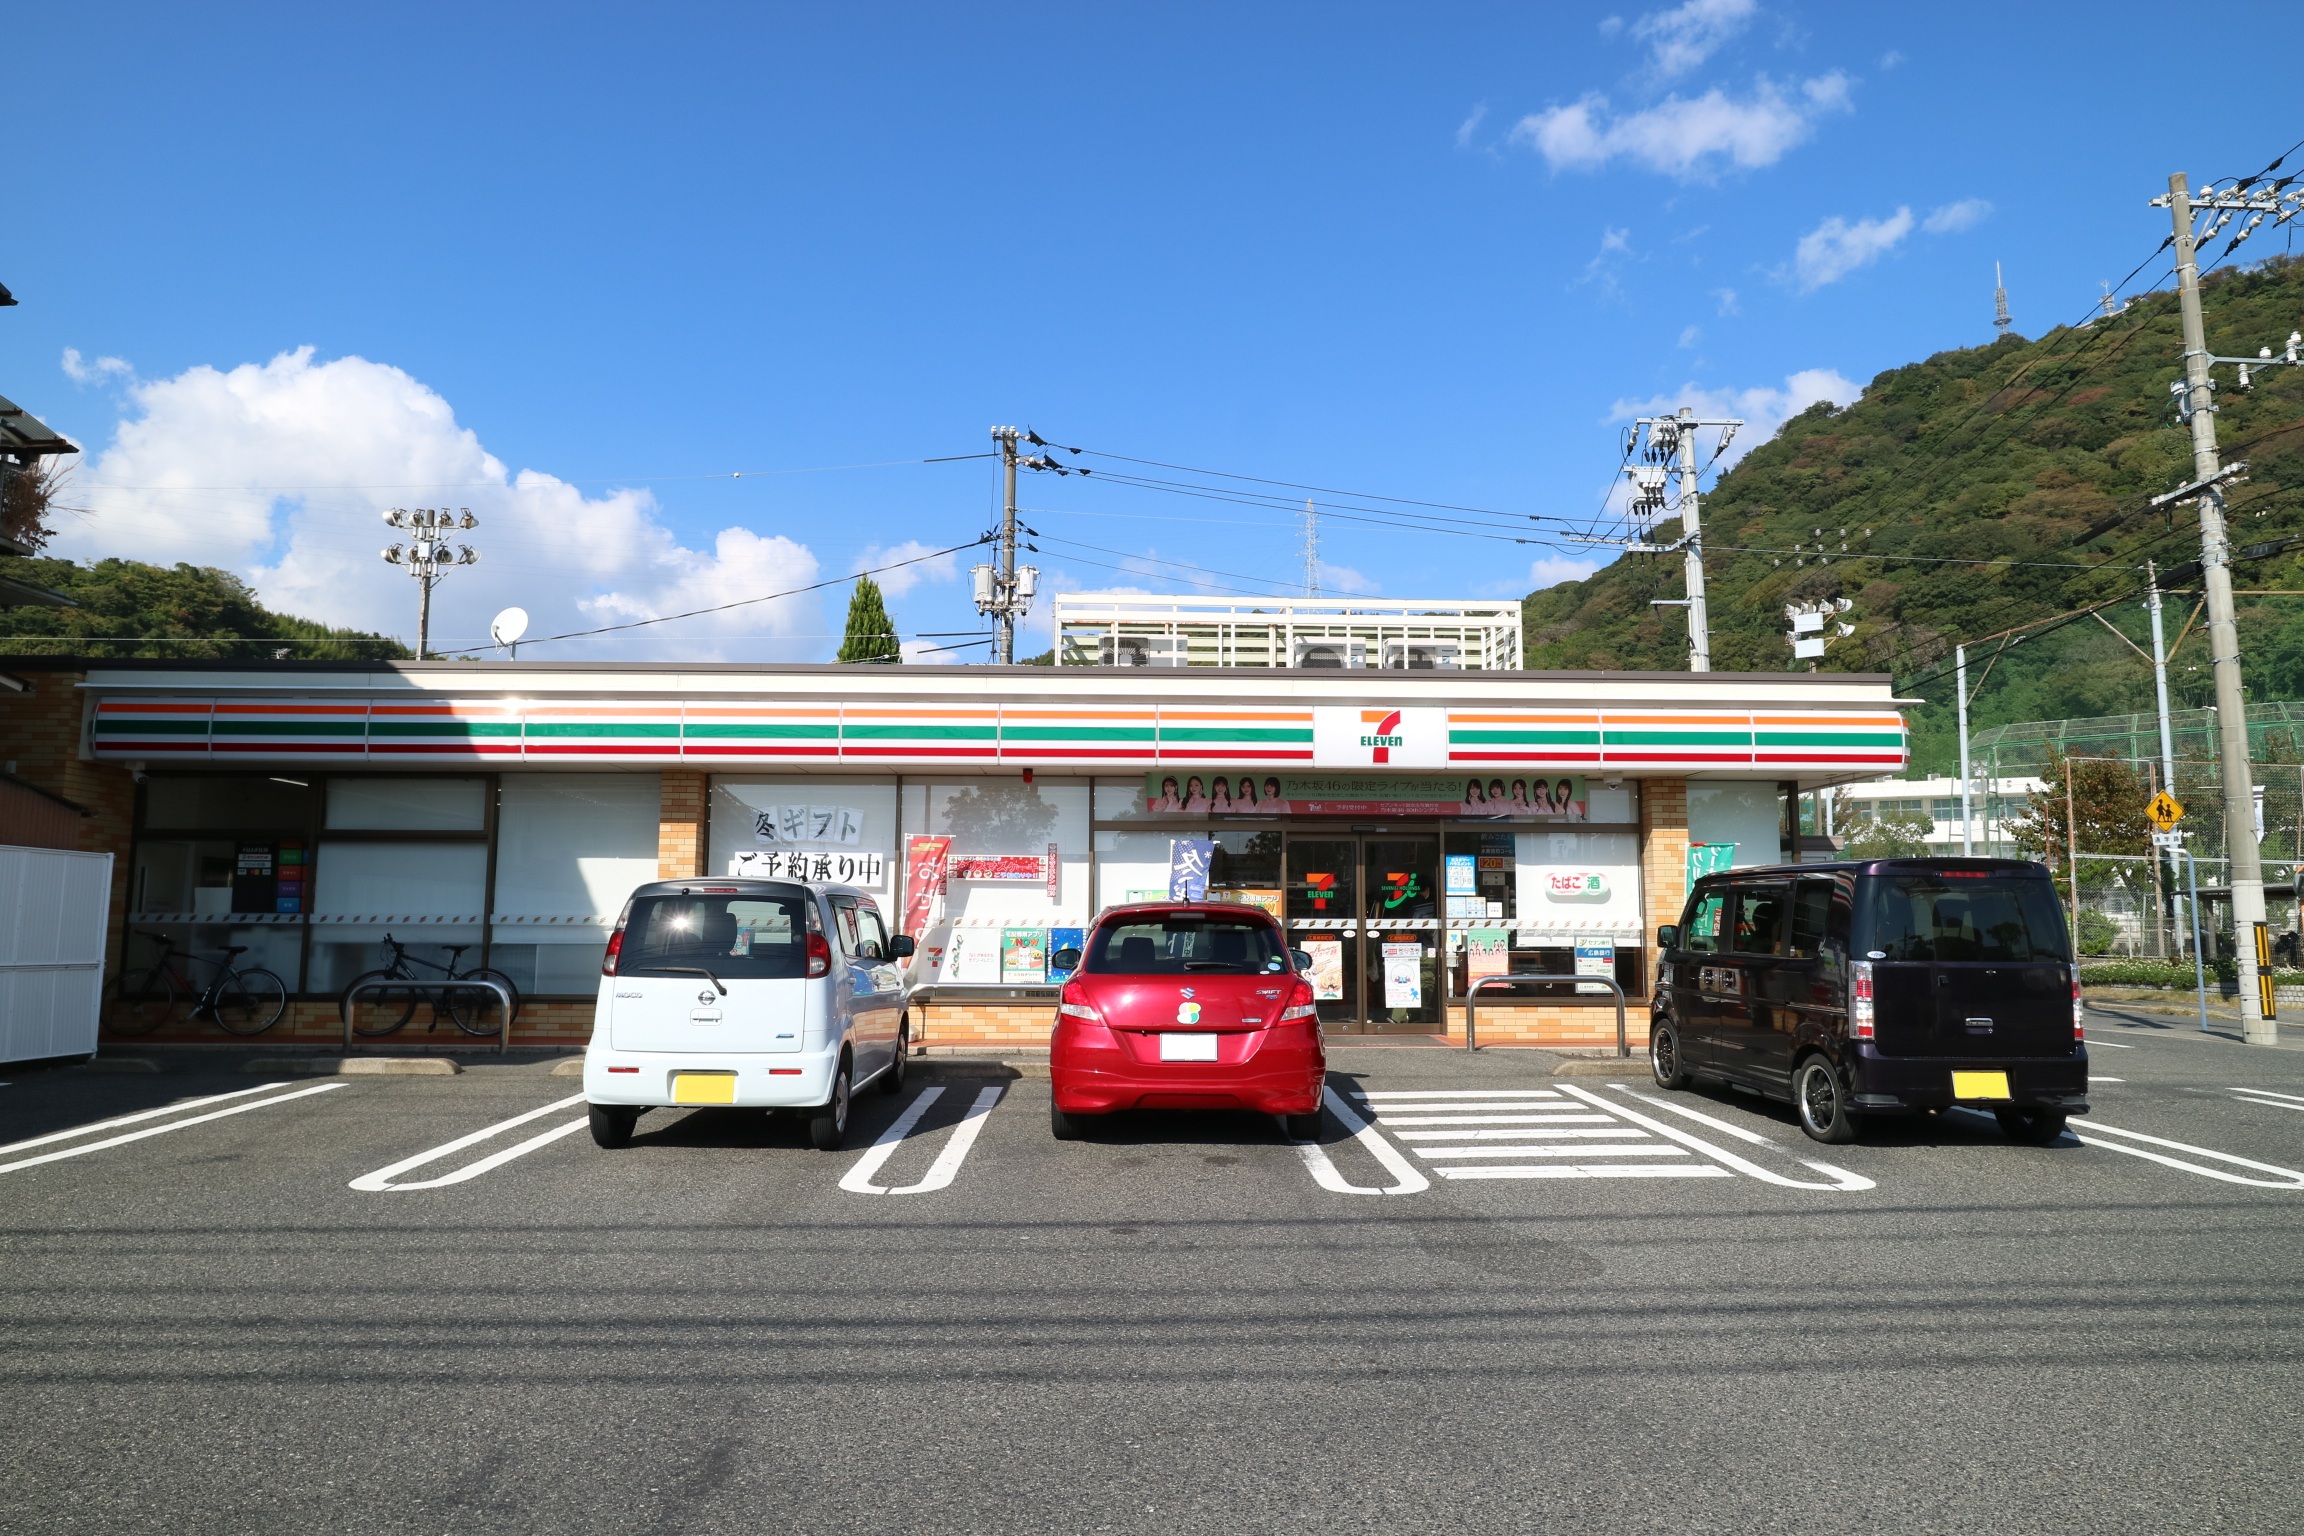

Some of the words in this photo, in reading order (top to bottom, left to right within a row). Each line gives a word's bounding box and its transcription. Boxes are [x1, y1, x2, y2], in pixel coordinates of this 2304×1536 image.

[755, 808, 857, 841] 冬ギフト
[737, 851, 881, 884] ご予約承り中
[958, 861, 1039, 872] クリスマスケーキ
[1551, 876, 1582, 889] たばこ
[1587, 876, 1600, 889] 酒
[1009, 938, 1040, 947] 7NOW
